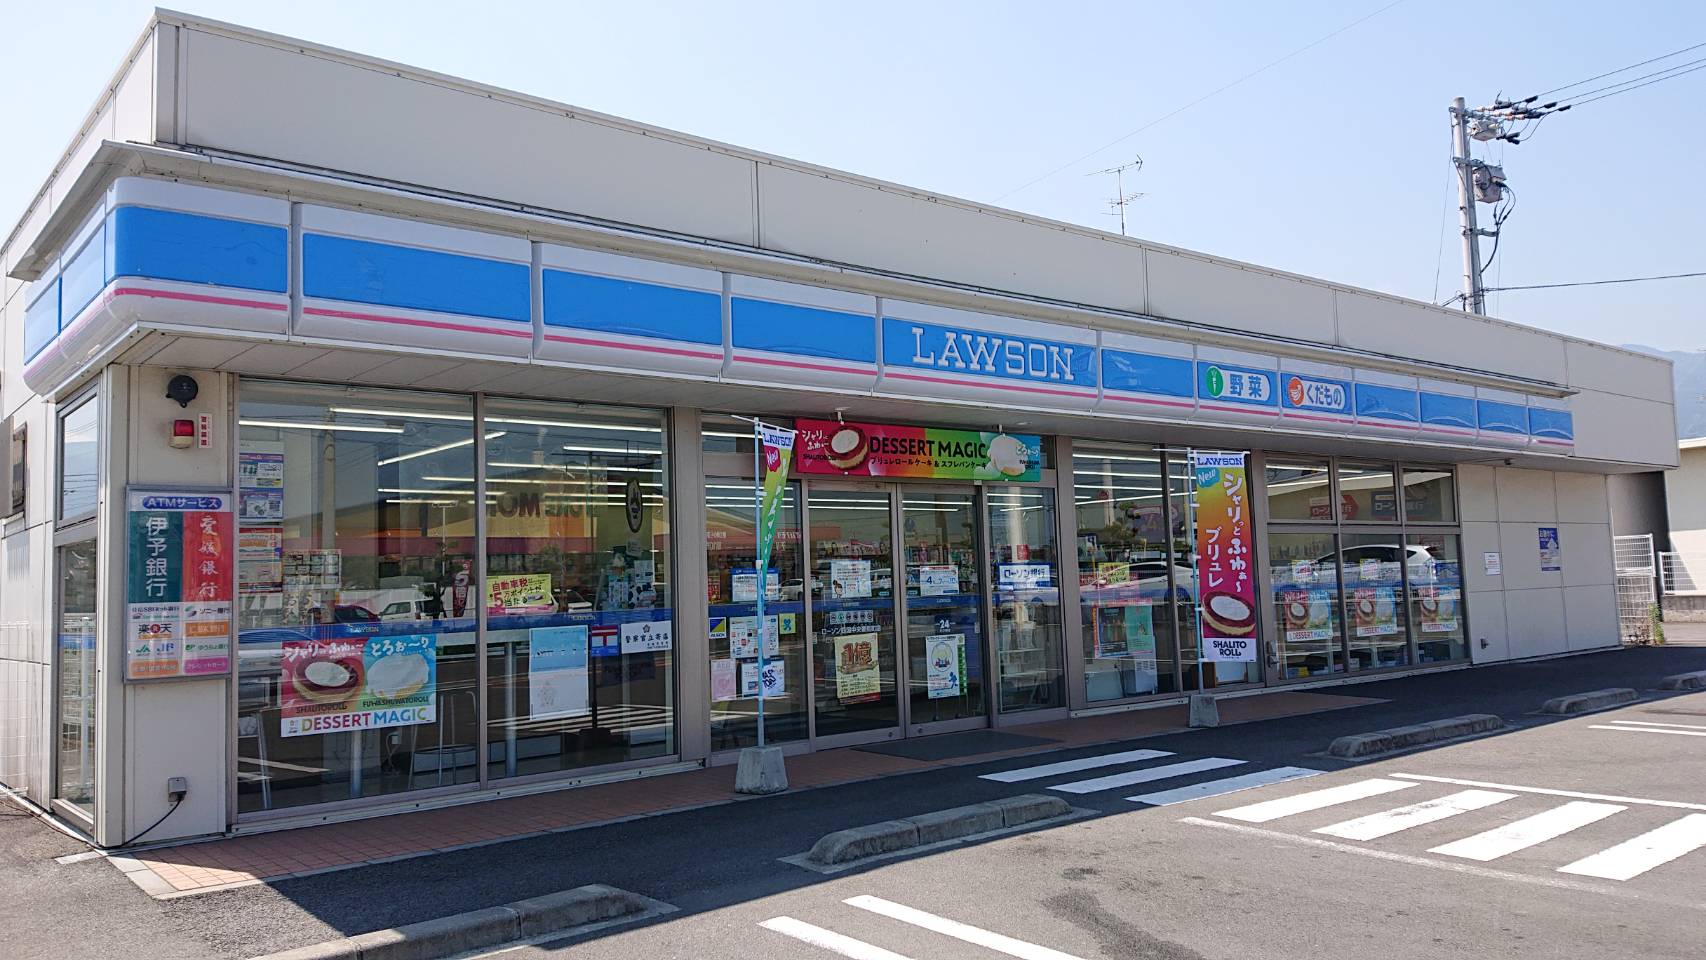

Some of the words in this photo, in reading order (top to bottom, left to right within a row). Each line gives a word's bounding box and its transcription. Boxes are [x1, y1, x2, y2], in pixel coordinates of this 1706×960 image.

[911, 326, 1074, 381] LAWSON
[1229, 372, 1262, 398] 野菜
[1306, 383, 1343, 407] くだもの
[870, 435, 935, 457] DESSERT
[938, 440, 986, 459] MAGIC
[1196, 456, 1243, 466] LAWSON
[1197, 471, 1216, 485] New
[147, 498, 218, 508] ATMサービス
[145, 516, 168, 599] 伊予銀行
[198, 515, 219, 598] 愛媛銀行
[1205, 526, 1223, 588] ブリュレ
[492, 577, 528, 592] 自動車税
[939, 619, 951, 631] 24
[1213, 641, 1246, 649] SHALITO
[301, 713, 371, 732] DESSERT
[373, 708, 428, 725] MAGIC
